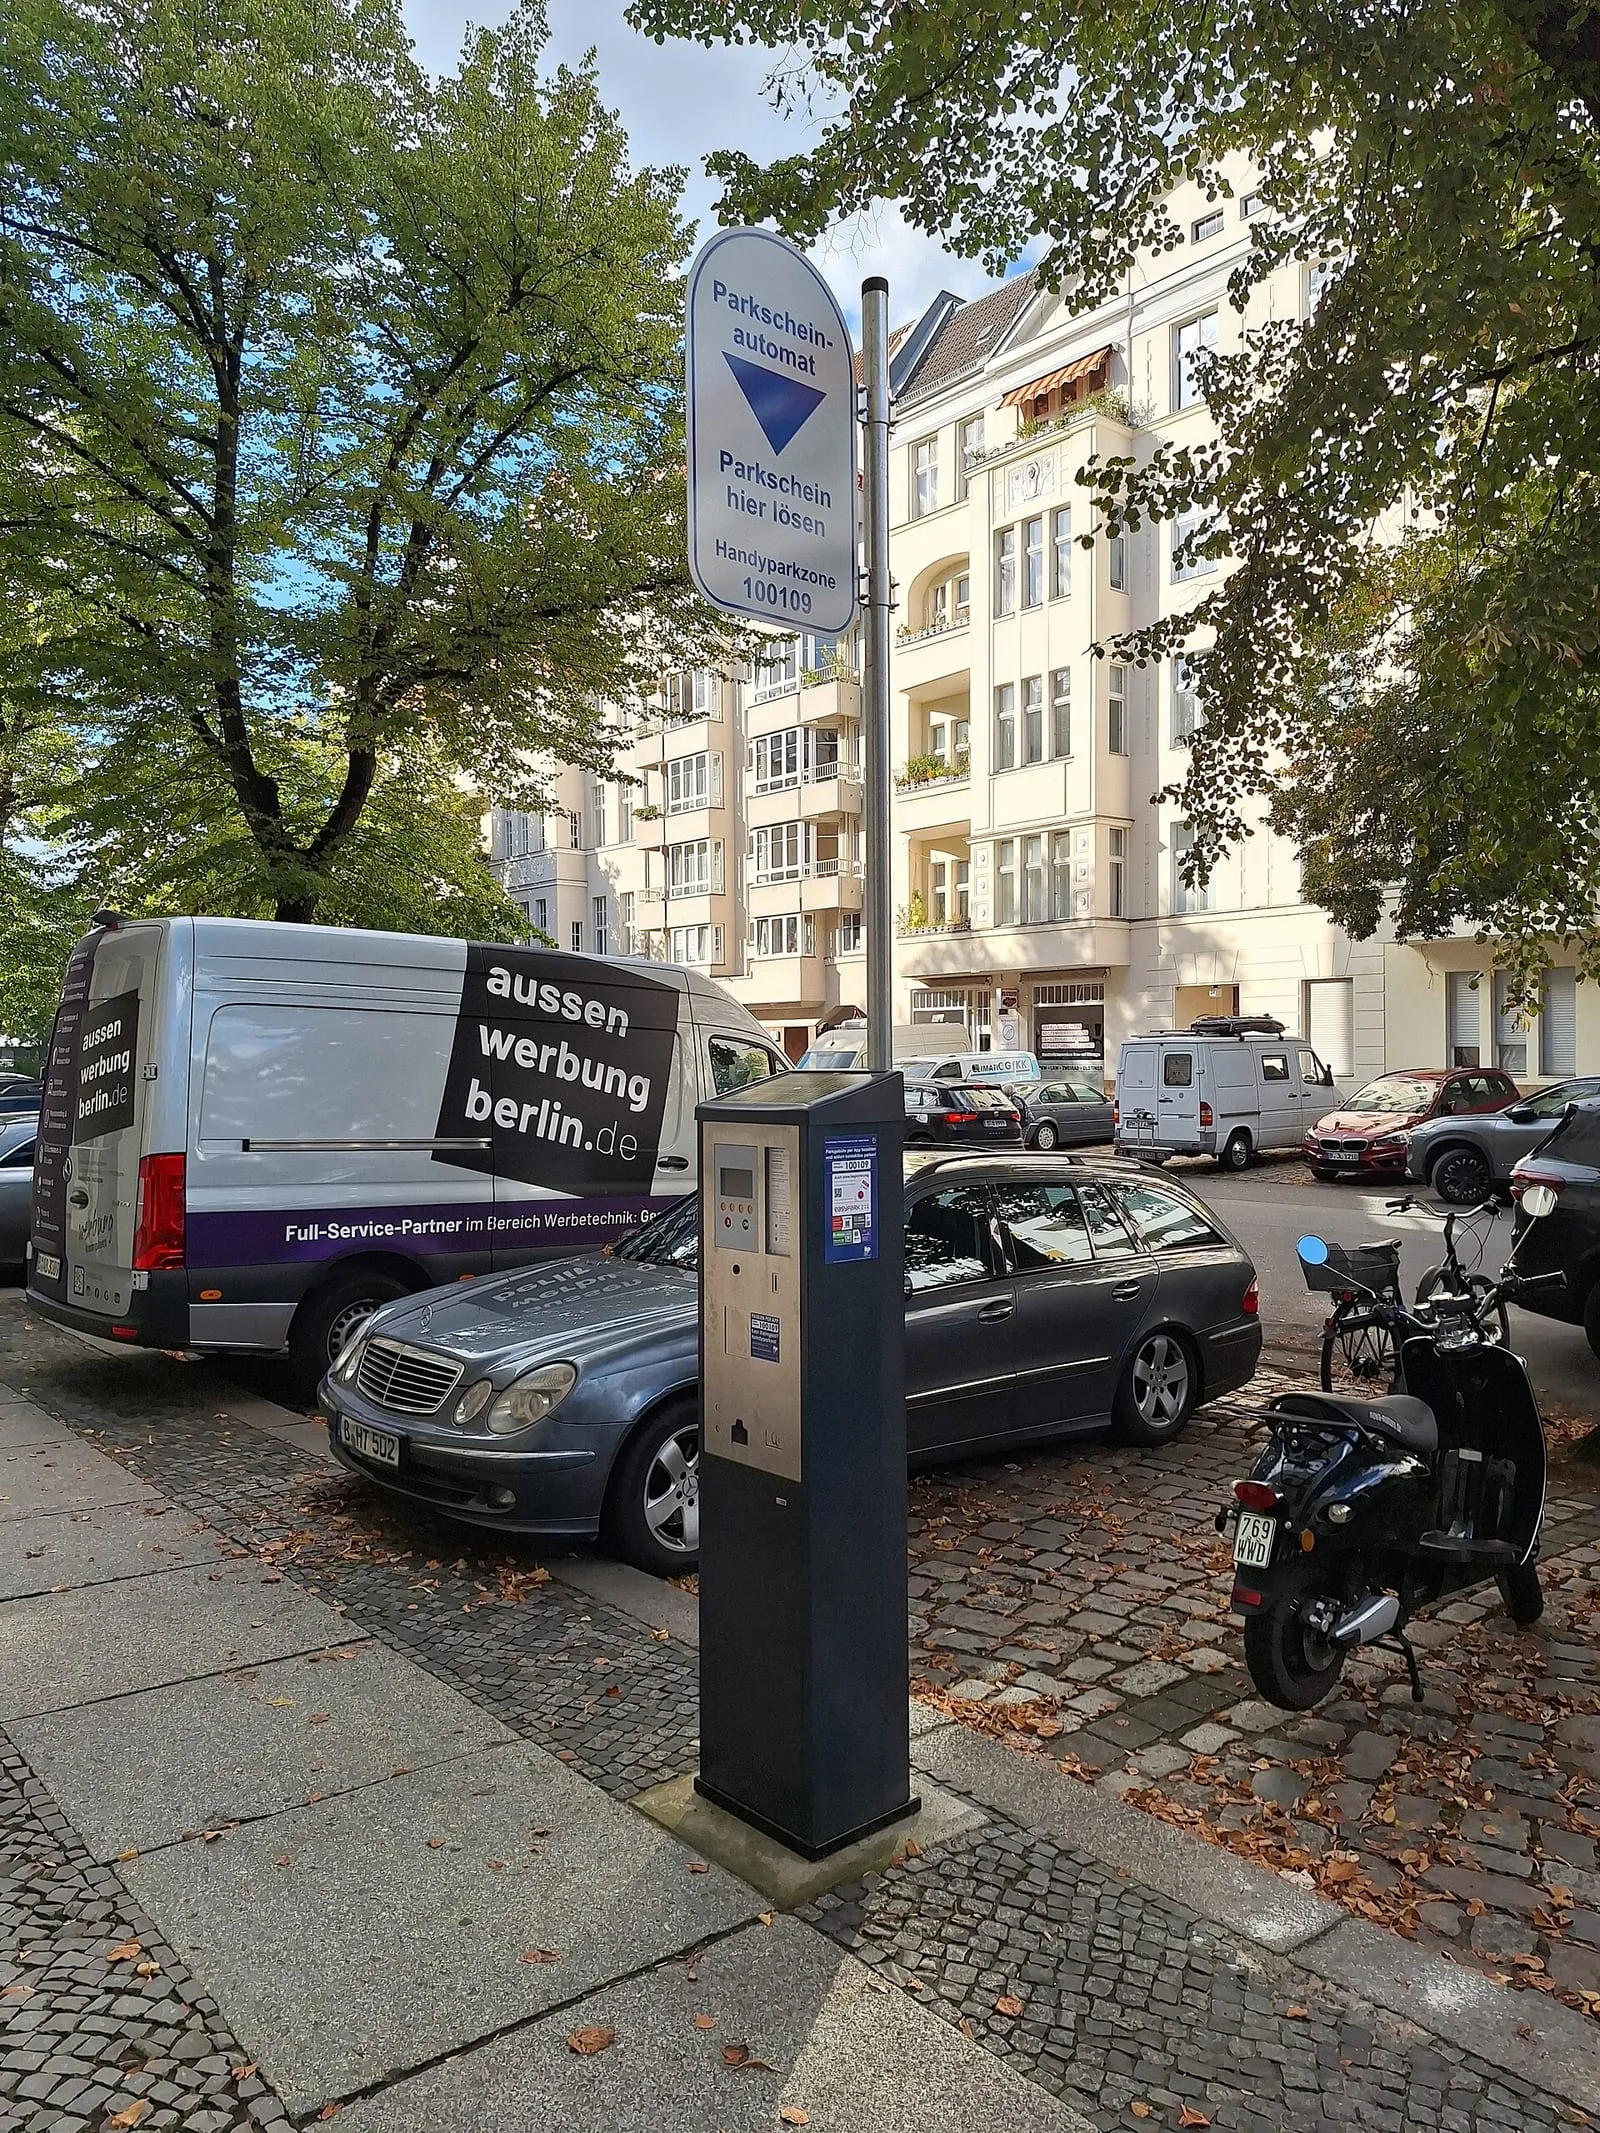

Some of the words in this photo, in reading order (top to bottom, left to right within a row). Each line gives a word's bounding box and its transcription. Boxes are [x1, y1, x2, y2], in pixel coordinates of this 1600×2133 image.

[713, 280, 833, 349] Parkschein-
[733, 327, 816, 376] automat
[719, 449, 832, 509] Parkschein
[727, 485, 767, 518] hier
[773, 500, 826, 538] lösen
[715, 538, 837, 590] Handyparkzone
[743, 576, 813, 615] 100109
[486, 966, 630, 1038] aussen
[82, 1019, 121, 1052] aussen
[80, 1050, 130, 1085] werbung
[478, 1024, 651, 1113] werbung
[78, 1082, 128, 1120] berlin.de
[465, 1078, 639, 1161] berlin.de
[845, 1161, 870, 1170] 100109
[286, 1217, 463, 1242] Full-Service-Partner
[465, 1216, 483, 1232] im
[487, 1210, 540, 1231] Bereich
[544, 1207, 637, 1227] Werbetechnik:
[343, 1419, 351, 1442] B
[355, 1424, 369, 1452] HT
[372, 1434, 396, 1461] 502
[1241, 1517, 1271, 1539] 769
[1237, 1538, 1266, 1562] WWD
